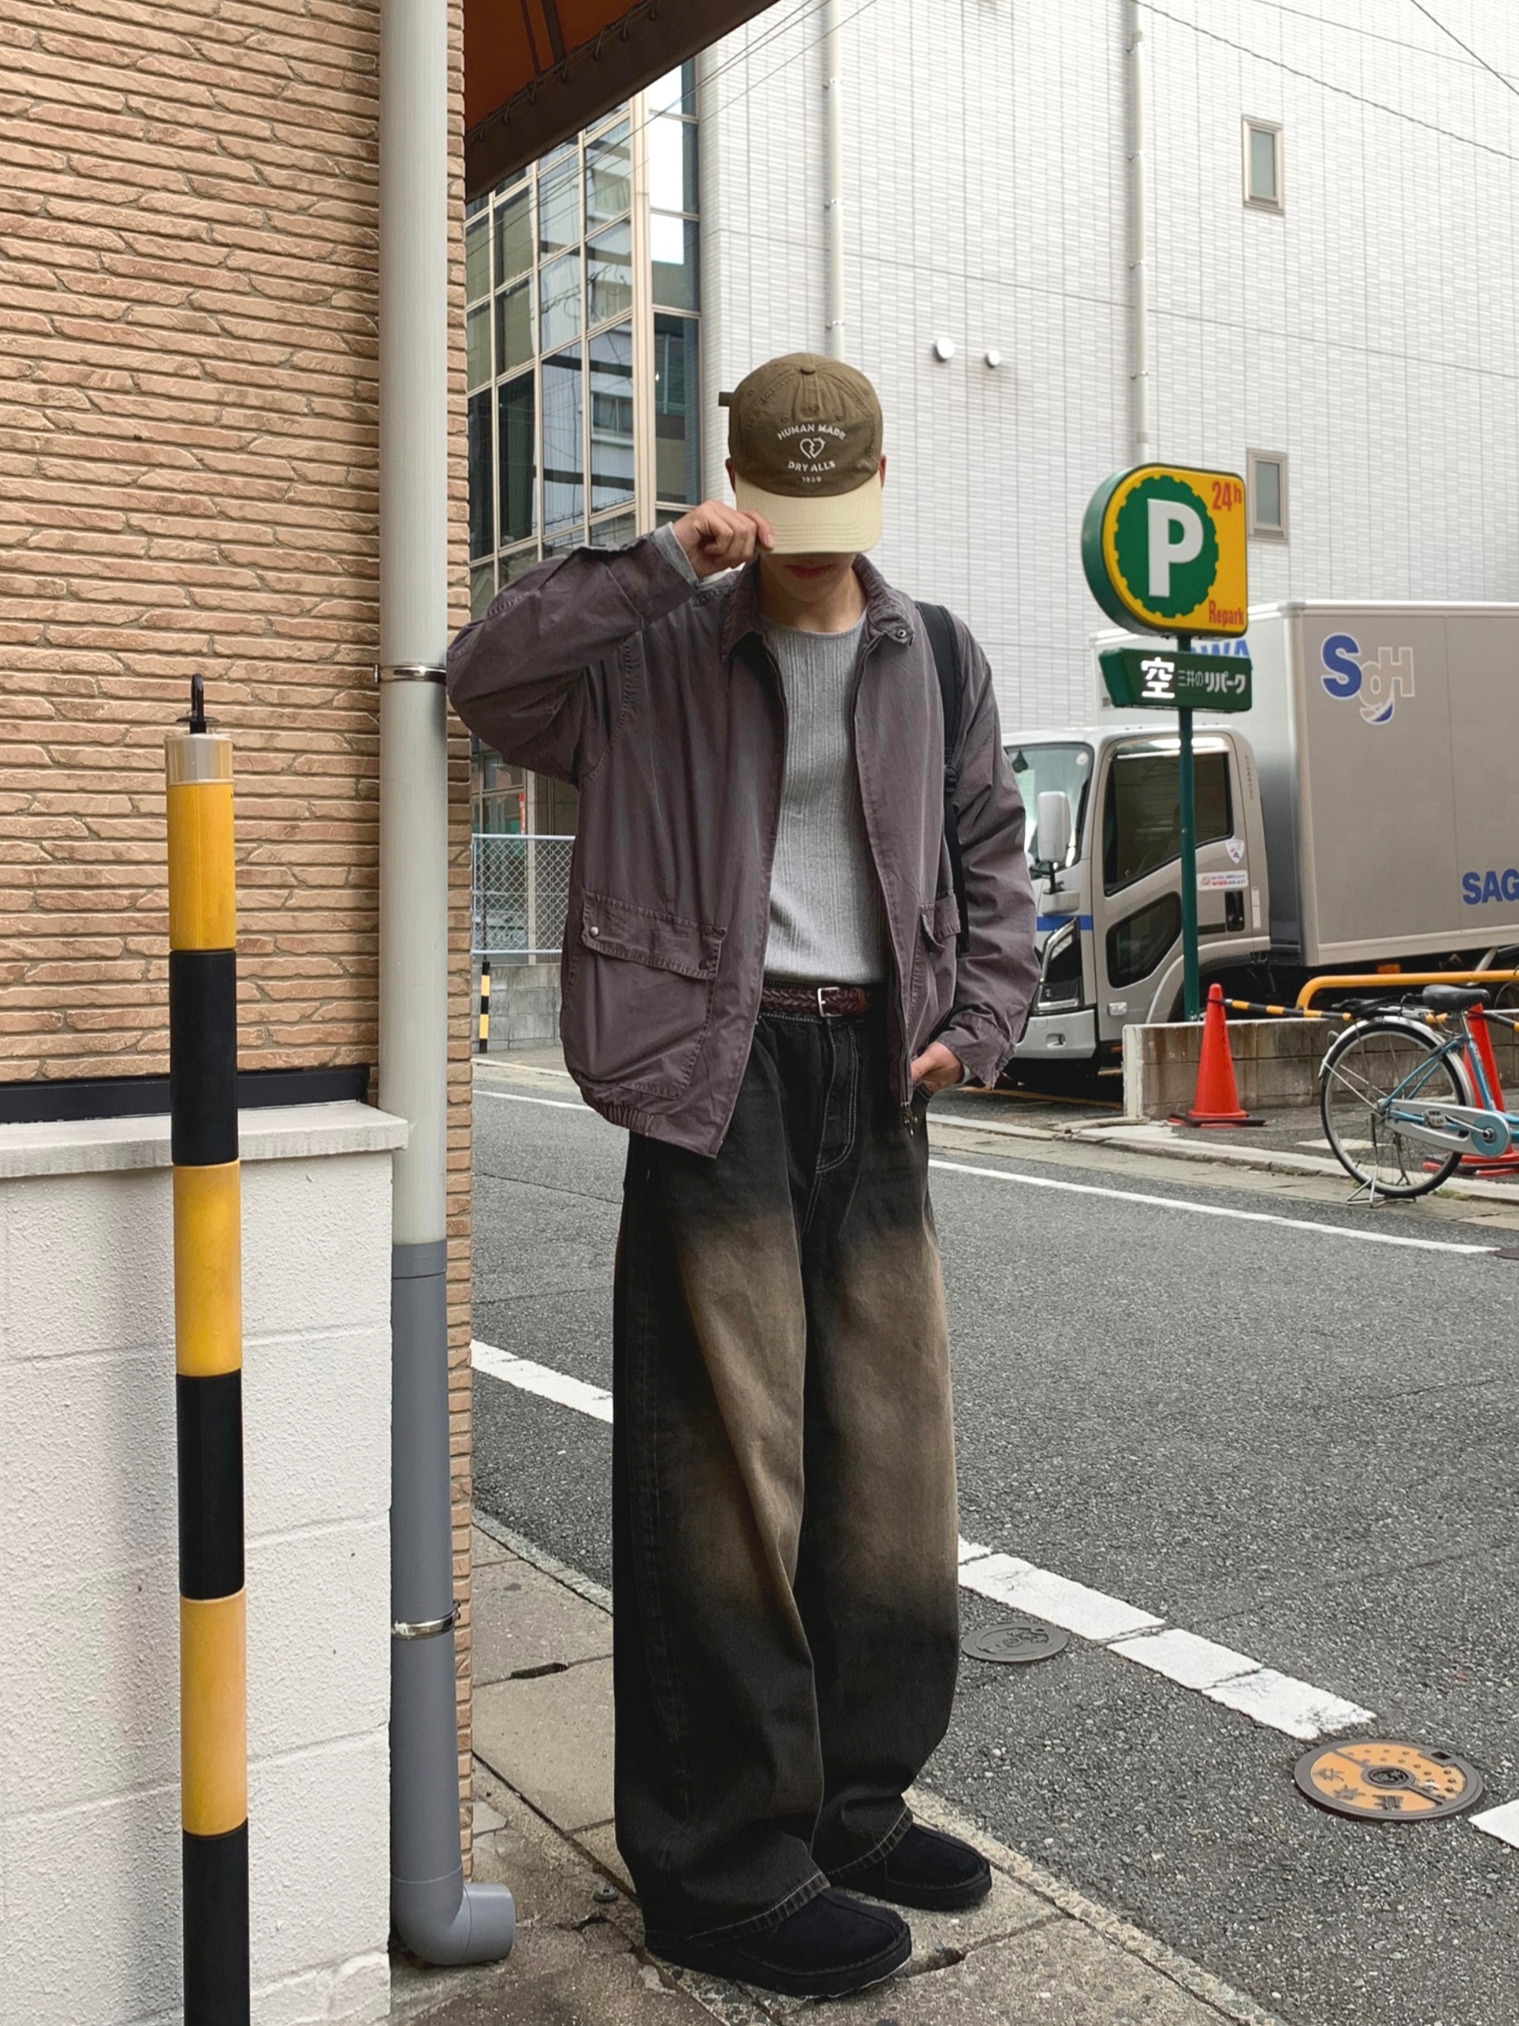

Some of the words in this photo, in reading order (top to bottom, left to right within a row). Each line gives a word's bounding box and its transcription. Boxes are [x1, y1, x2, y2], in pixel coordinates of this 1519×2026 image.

[777, 424, 815, 440] HUMAN
[818, 424, 846, 440] MADE
[788, 461, 809, 472] DRY
[810, 460, 835, 472] ALLS
[1211, 480, 1242, 512] 24h
[1147, 498, 1204, 598] P
[1208, 599, 1244, 627] Repark
[1140, 656, 1175, 699] 空
[1177, 669, 1246, 694] 三井のリパーク
[1462, 868, 1519, 905] SAG
